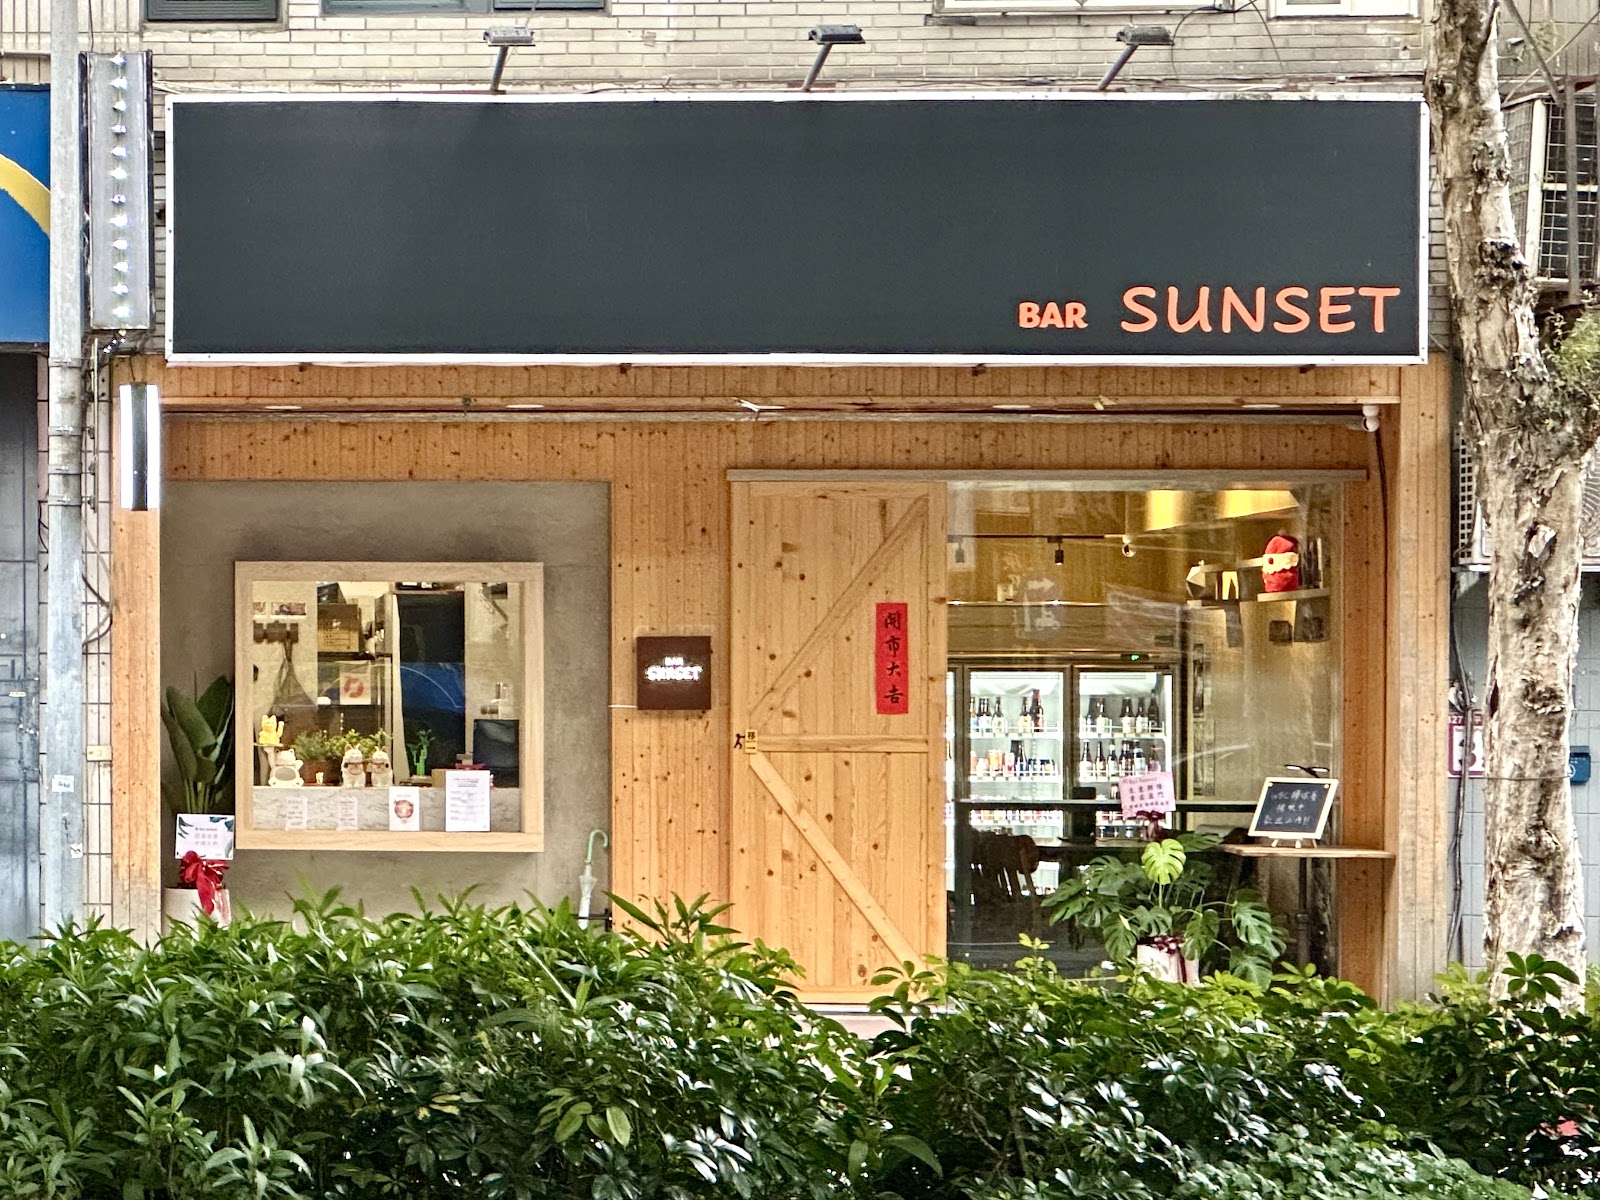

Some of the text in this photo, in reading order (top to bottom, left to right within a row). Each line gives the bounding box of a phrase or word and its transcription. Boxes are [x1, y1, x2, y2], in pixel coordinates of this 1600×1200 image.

[1018, 285, 1401, 335] BAR SUNSET
[883, 610, 905, 705] 開市大吉
